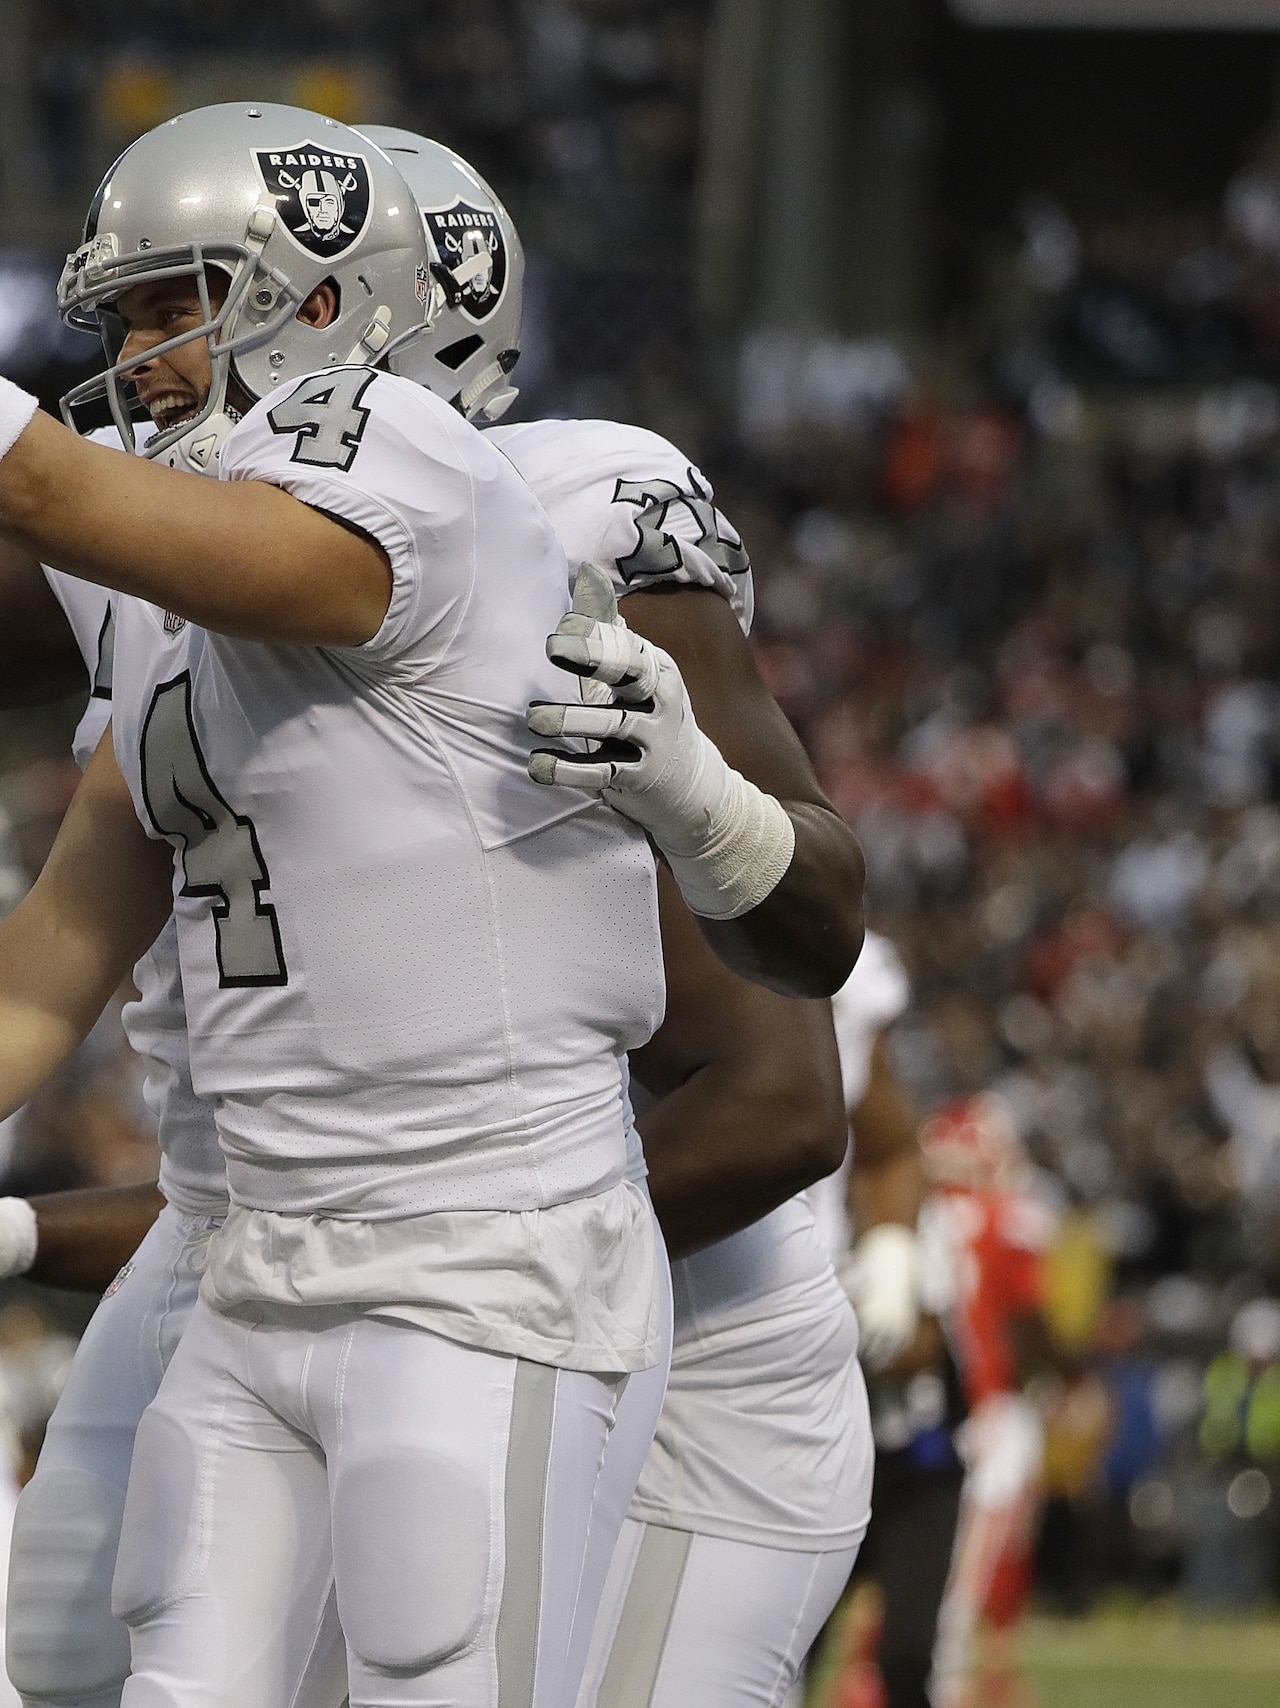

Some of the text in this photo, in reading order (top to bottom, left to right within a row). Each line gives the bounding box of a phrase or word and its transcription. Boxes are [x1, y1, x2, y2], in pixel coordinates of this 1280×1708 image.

[269, 154, 358, 170] RAIDERS
[435, 213, 495, 228] RAIDERS
[266, 367, 378, 473] 4
[139, 668, 289, 989] 4
